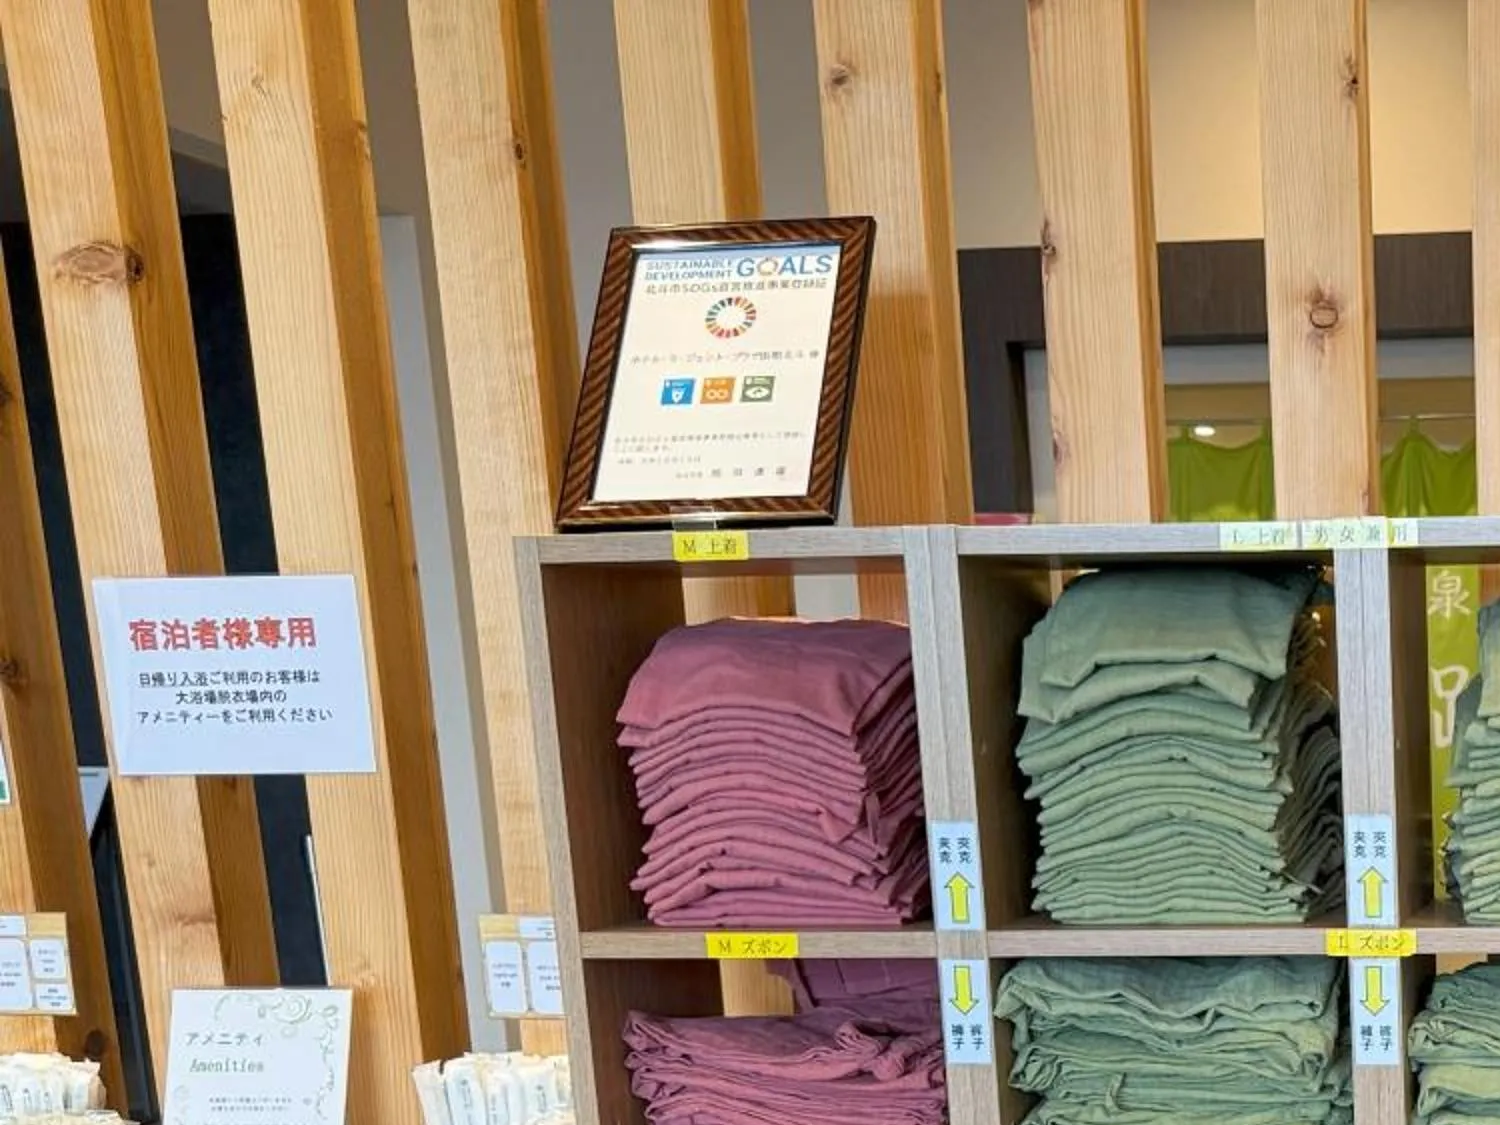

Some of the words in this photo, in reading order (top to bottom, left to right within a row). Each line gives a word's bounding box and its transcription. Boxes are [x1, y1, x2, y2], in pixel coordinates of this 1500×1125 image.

[646, 260, 732, 270] SUSTAINABLE
[737, 254, 833, 278] GOALS
[645, 269, 732, 281] DEVELOPMENT
[1427, 569, 1471, 619] 泉
[128, 616, 317, 651] 宿泊者様専用
[138, 670, 321, 687] 日帰り入浴ご利用のお客様は
[137, 709, 333, 724] アメニティーをご利用ください
[719, 939, 731, 954] M
[741, 937, 788, 955] ズボン
[1359, 934, 1407, 952] ズボン
[185, 1032, 264, 1047] アメニティ
[189, 1057, 265, 1074] Amenities
